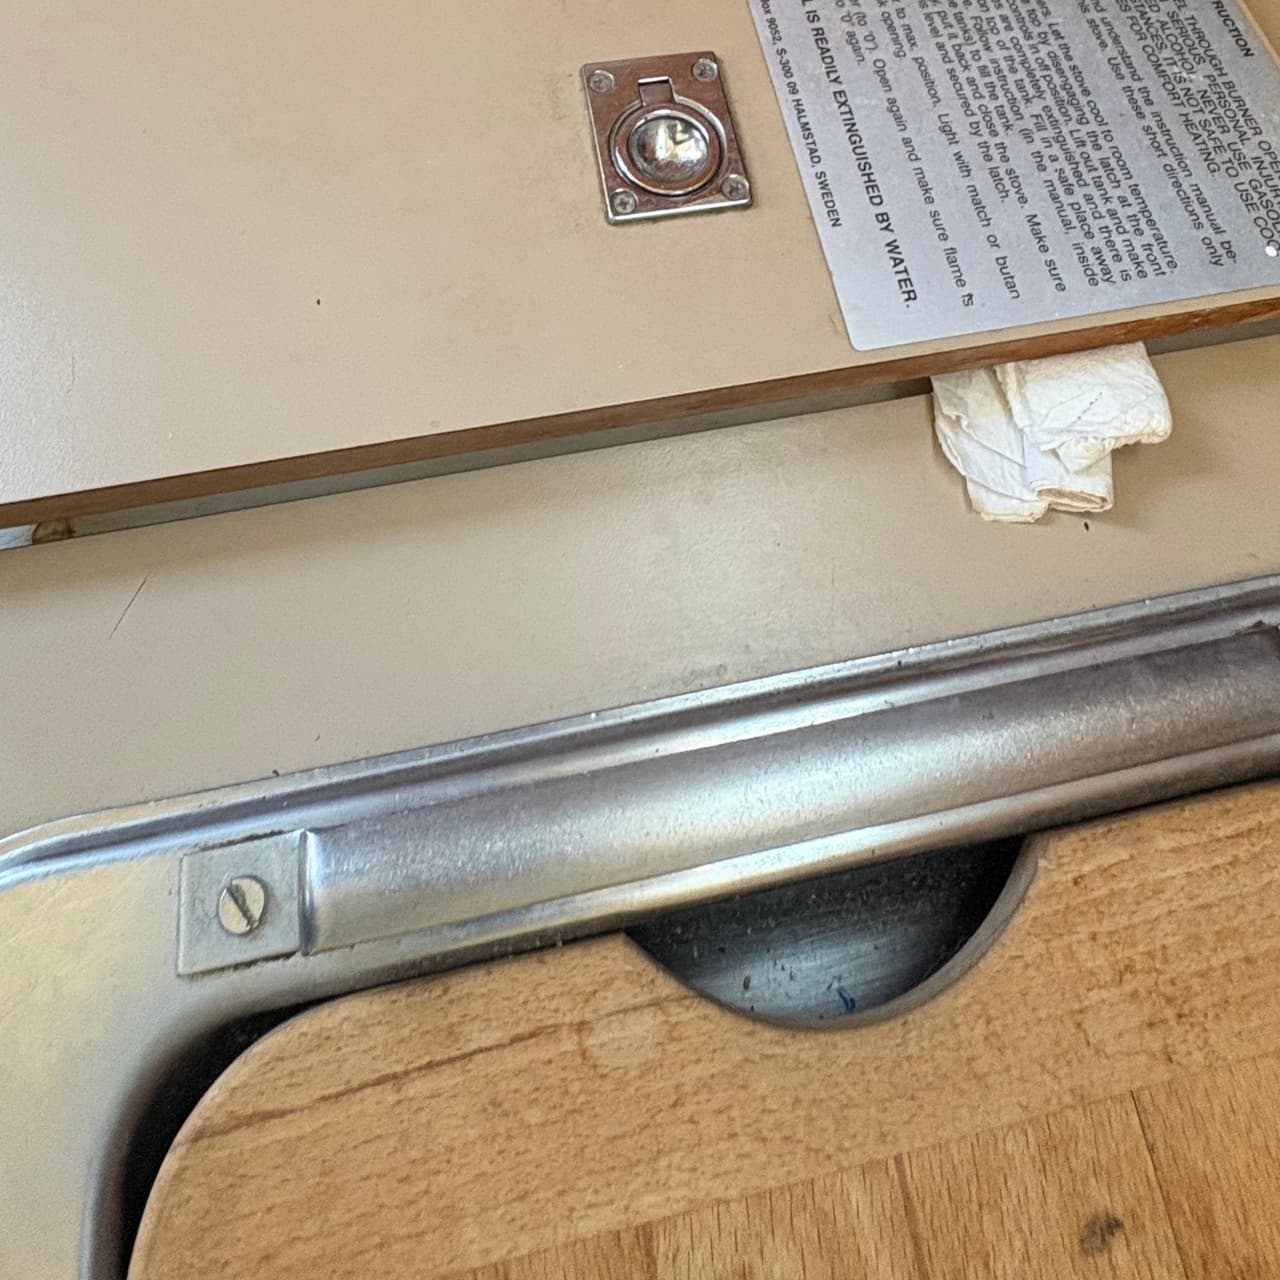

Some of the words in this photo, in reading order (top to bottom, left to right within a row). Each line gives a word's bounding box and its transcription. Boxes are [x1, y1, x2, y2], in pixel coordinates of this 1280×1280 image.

[805, 9, 821, 24] IS
[880, 11, 907, 59] opening.
[933, 10, 953, 29] put
[953, 11, 976, 46] tanks)
[811, 27, 842, 85] READILY
[845, 30, 865, 65] again.
[947, 32, 959, 41] it
[969, 49, 982, 62] to
[1028, 43, 1040, 55] in
[775, 48, 794, 79] S-300
[952, 43, 971, 72] back
[977, 64, 991, 78] fill
[1034, 56, 1051, 71] off
[1185, 15, 1228, 77] THROUGH
[1223, 80, 1263, 136] BURNER
[786, 81, 800, 96] 09
[965, 76, 985, 100] and
[983, 81, 999, 101] the
[1126, 16, 1148, 42] FOR
[1142, 44, 1185, 107] COMFORT
[1179, 113, 1220, 176] HEATING.
[1167, 10, 1206, 65] SERIOUS
[1203, 74, 1251, 146] PERSONAL
[923, 12, 943, 39] level
[935, 41, 954, 64] and
[946, 68, 976, 117] secured
[968, 121, 983, 137] by
[977, 140, 993, 163] the
[988, 166, 1010, 203] latch.
[1041, 74, 1073, 126] position.
[792, 98, 821, 167] HALMSTAD,
[977, 104, 999, 138] close
[994, 104, 1014, 136] tank.
[1069, 128, 1087, 149] Lift
[1163, 56, 1179, 67] IT
[1172, 71, 1188, 84] IS
[1180, 87, 1205, 114] NOT
[1198, 119, 1227, 154] SAFE
[1221, 158, 1240, 178] TO
[1234, 181, 1260, 213] USE
[1197, 89, 1231, 134] NEVER
[1227, 141, 1252, 171] USE
[833, 90, 883, 206] EXTINGUISHED
[970, 15, 993, 53] Follow
[989, 58, 1024, 121] instruction
[1018, 128, 1035, 145] (in
[1030, 150, 1047, 173] the
[1043, 179, 1076, 235] manual,
[1072, 242, 1099, 287] inside
[980, 16, 1001, 36] top
[995, 39, 1011, 51] of
[1003, 55, 1019, 74] the
[1014, 78, 1033, 105] tank.
[1029, 113, 1048, 132] Fill
[1040, 137, 1053, 149] in
[1048, 154, 1059, 163] a
[1054, 168, 1075, 196] safe
[1068, 201, 1095, 240] place
[1090, 246, 1115, 284] away
[994, 141, 1010, 163] the
[998, 14, 1014, 32] are
[1009, 36, 1046, 100] completely
[1041, 105, 1089, 188] extinguished
[1083, 193, 1105, 220] and
[1098, 225, 1123, 263] there
[1119, 269, 1133, 282] is
[1026, 8, 1042, 27] top
[1037, 31, 1051, 46] by
[1047, 51, 1090, 126] disengaging
[1086, 130, 1103, 151] the
[1099, 157, 1121, 189] latch
[1117, 195, 1132, 208] at
[1126, 213, 1145, 237] the
[1141, 243, 1166, 277] front
[1047, 22, 1065, 41] Let
[1058, 42, 1074, 62] the
[1069, 64, 1092, 97] stove
[1086, 99, 1109, 127] cool
[1101, 129, 1114, 143] to
[1109, 145, 1133, 181] room
[1128, 183, 1178, 273] temperature.
[1086, 18, 1108, 52] stove.
[1107, 56, 1125, 81] Use
[1122, 85, 1146, 120] these
[1142, 125, 1168, 158] short
[1163, 163, 1204, 230] directions
[1201, 236, 1224, 267] only
[1101, 17, 1143, 82] understand
[1137, 86, 1154, 107] the
[1151, 111, 1192, 178] instruction
[1190, 183, 1225, 235] manual
[1220, 240, 1237, 263] be-
[901, 23, 918, 51] max.
[911, 56, 941, 107] position.
[937, 113, 960, 146] Light
[953, 151, 972, 178] with
[967, 184, 992, 228] match
[986, 234, 1001, 249] or
[995, 256, 1020, 299] butan
[1079, 151, 1098, 173] out
[815, 171, 842, 227] SWEDEN
[872, 58, 893, 93] Open
[886, 97, 908, 132] again
[901, 137, 922, 162] and
[913, 167, 935, 205] make
[929, 210, 949, 242] sure
[943, 247, 966, 288] flame
[961, 292, 974, 307] is
[1005, 168, 1028, 208] stove.
[1091, 175, 1113, 205] tank
[874, 212, 894, 233] BY
[1025, 214, 1049, 253] Make
[1106, 208, 1130, 235] and
[885, 239, 917, 307] WATER.
[1044, 259, 1066, 292] sure
[1122, 238, 1148, 279] make
